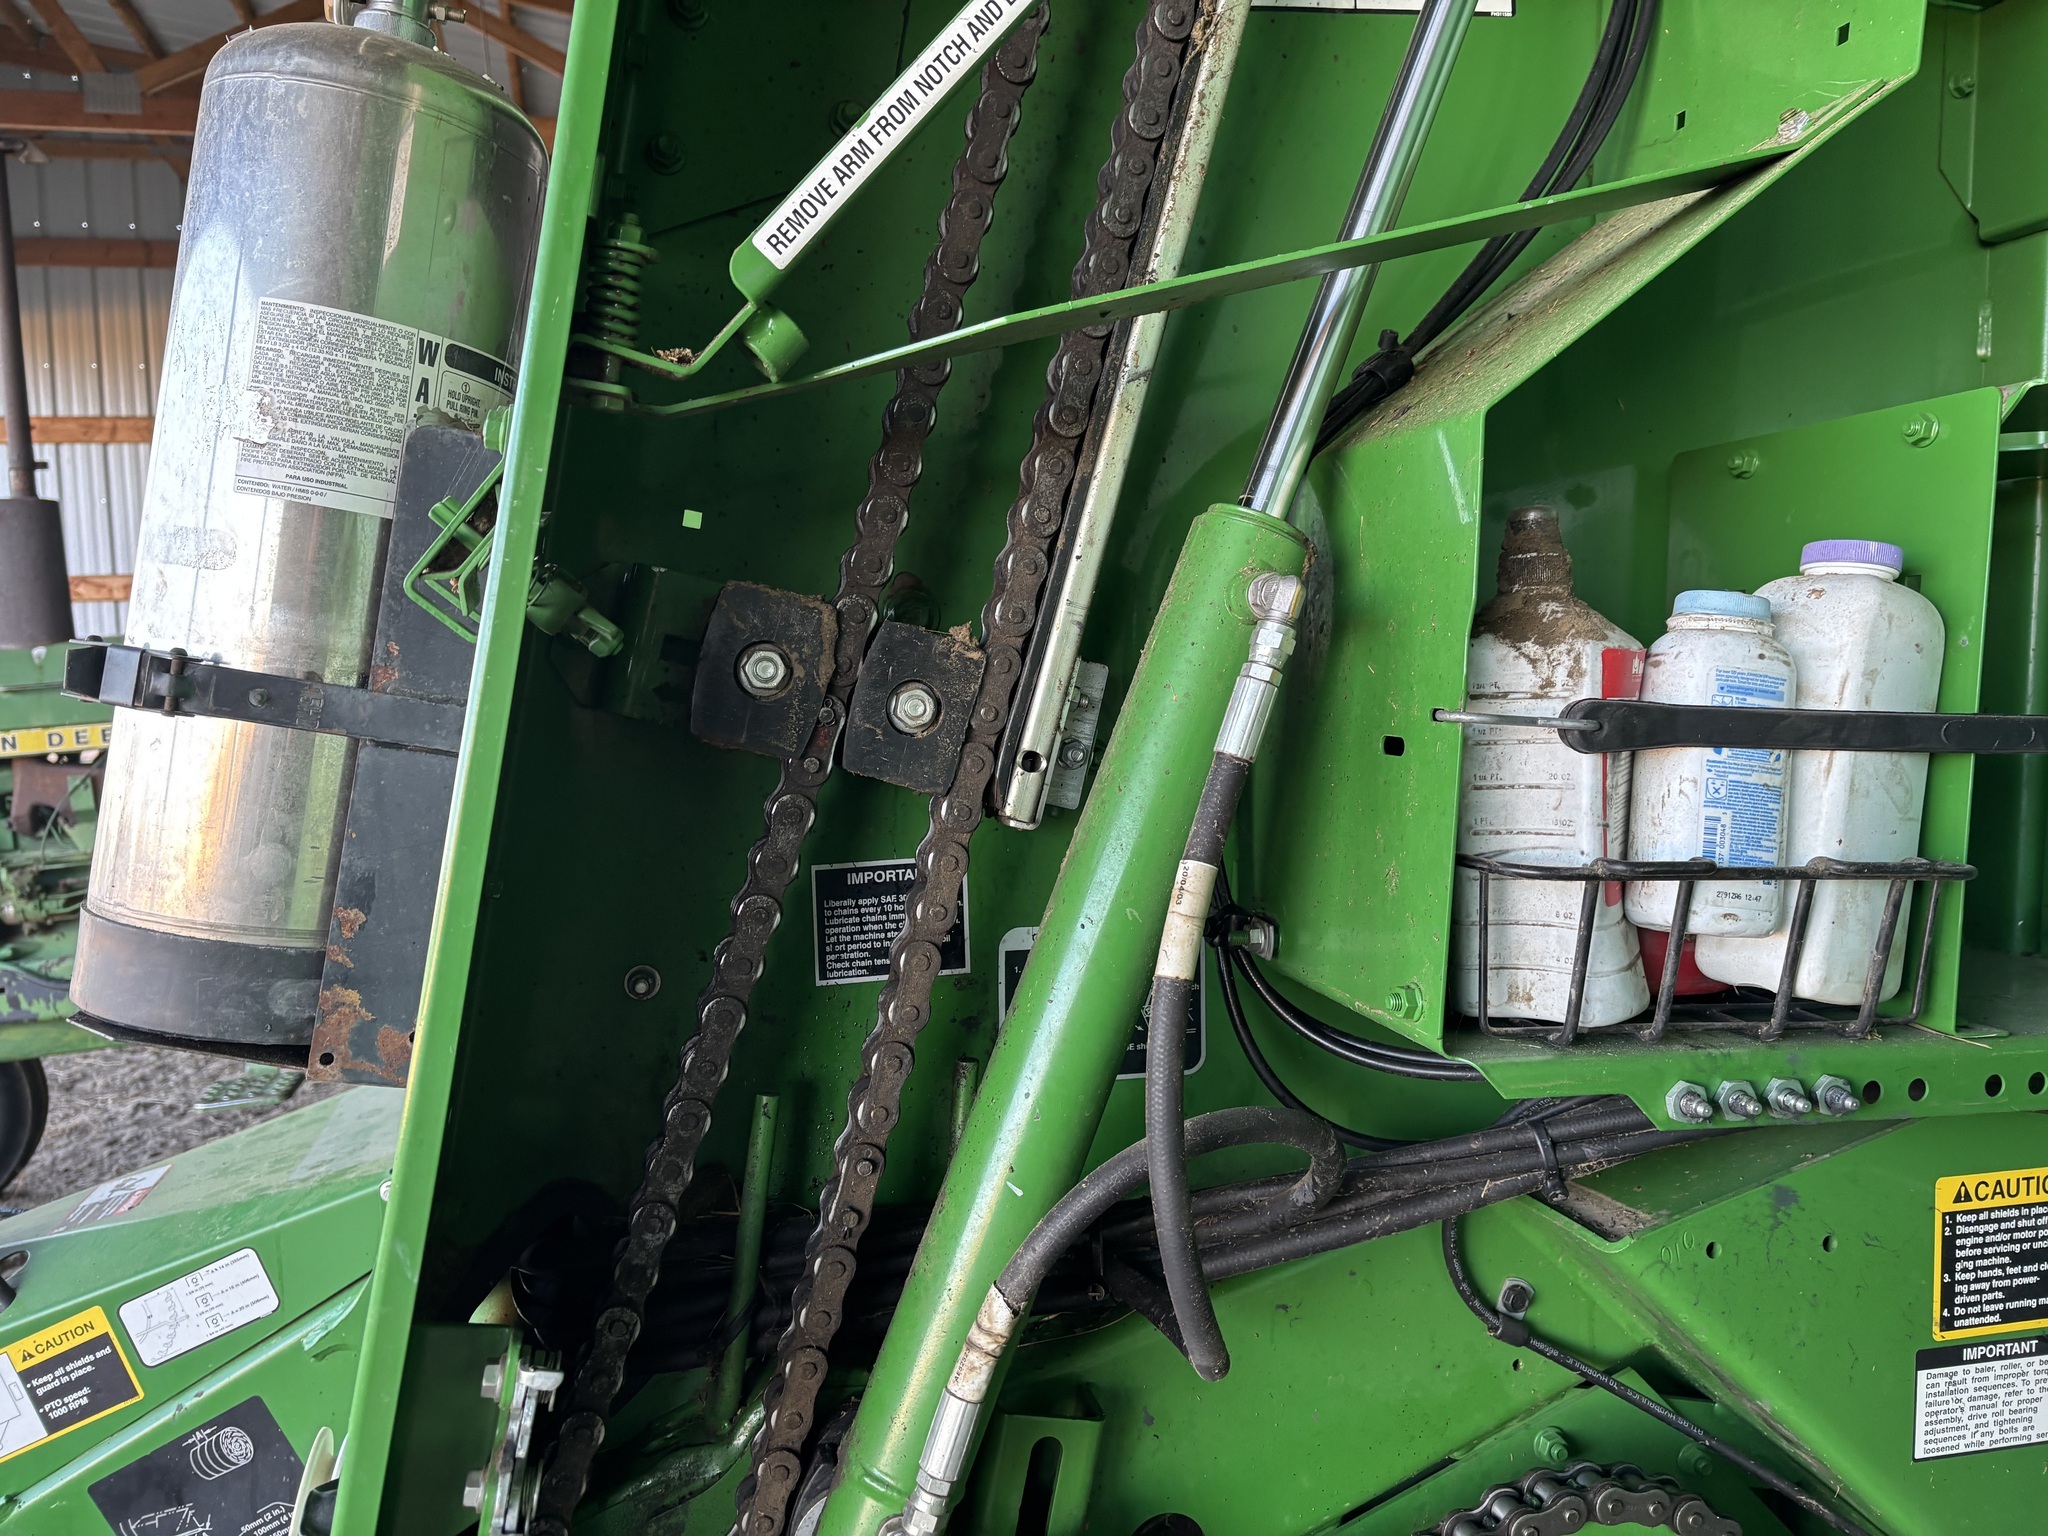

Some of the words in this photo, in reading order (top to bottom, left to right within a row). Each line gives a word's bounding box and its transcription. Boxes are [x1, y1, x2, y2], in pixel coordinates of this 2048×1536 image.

[766, 178, 837, 254] REMOVE
[832, 138, 874, 186] ARM
[867, 89, 920, 145] FROM
[913, 33, 971, 96] NOTCH
[967, 0, 1002, 42] AND
[309, 309, 350, 320] INSPECCIONAR
[352, 317, 396, 331] MENSUALMENTE
[447, 389, 461, 400] HOLD
[445, 399, 458, 411] PULL
[314, 478, 347, 489] INDUSTRIAL
[236, 485, 270, 495] CONTENIDOS
[286, 492, 311, 501] PRESION
[847, 868, 917, 884] IMPORTA
[1175, 866, 1190, 905] 20/04/03
[824, 898, 856, 907] Liberally
[858, 896, 878, 906] apply
[824, 916, 860, 925] Lubricate
[861, 914, 886, 922] chains
[833, 907, 858, 915] chains
[825, 925, 860, 935] operation
[852, 931, 884, 940] machine
[847, 941, 871, 952] period
[826, 960, 850, 969] Check
[826, 968, 868, 977] lubrication.
[1945, 1215, 1952, 1223] 1.
[1956, 1213, 1977, 1222] Keep
[1978, 1210, 1988, 1220] all
[1990, 1208, 2019, 1218] shields
[2021, 1206, 2029, 1215] in
[2030, 1205, 2048, 1216] plac
[1944, 1226, 1951, 1235] 2.
[1956, 1223, 1998, 1234] Disengage
[2000, 1219, 2015, 1229] and
[2017, 1217, 2035, 1227] shut
[2036, 1216, 2048, 1225] off
[1955, 1236, 1983, 1246] engine
[1985, 1232, 2011, 1242] and/or
[2012, 1230, 2036, 1239] motor
[1955, 1248, 1981, 1257] before
[1983, 1242, 2020, 1254] servicing
[1955, 1260, 1973, 1271] ging
[1975, 1255, 2011, 1266] machine.
[1943, 1274, 1950, 1282] 3.
[1955, 1272, 1975, 1281] Keep
[1977, 1267, 2004, 1278] hands,
[2006, 1265, 2021, 1274] feet
[2022, 1262, 2038, 1272] and
[1954, 1284, 1968, 1293] ing
[1969, 1281, 1990, 1290] away
[1992, 1279, 2010, 1287] from
[2012, 1276, 2040, 1287] power-
[1954, 1294, 1980, 1304] driven
[1981, 1290, 2004, 1302] parts.
[1942, 1308, 1950, 1316] 4.
[1954, 1306, 1965, 1315] Do
[1967, 1304, 1981, 1314] not
[1982, 1302, 2004, 1311] leave
[2005, 1298, 2036, 1309] running
[1954, 1313, 2001, 1327] unattended.
[34, 1320, 94, 1354] CAUTION
[1963, 1340, 2037, 1360] IMPORTANT
[31, 1373, 53, 1386] Keep
[54, 1366, 64, 1376] all
[65, 1354, 94, 1371] shields
[95, 1345, 111, 1358] and
[1566, 1356, 1608, 1382] HYDRAULIC
[1926, 1370, 1958, 1380] Damage
[2000, 1362, 2022, 1370] roller,
[36, 1378, 60, 1396] guard
[69, 1365, 95, 1380] place.
[1944, 1377, 1966, 1387] result
[1993, 1370, 2029, 1381] improper
[1925, 1387, 1968, 1398] installation
[1973, 1381, 2017, 1392] sequences.
[44, 1398, 62, 1411] PTO
[63, 1386, 90, 1403] speed:
[48, 1406, 68, 1418] 1000
[68, 1396, 88, 1410] RPM
[1626, 1388, 1676, 1420] HYDRAULICS
[1924, 1406, 1964, 1417] operator's
[1969, 1401, 1997, 1411] manual
[2017, 1396, 2042, 1406] proper
[1925, 1399, 1950, 1408] failure
[1967, 1393, 2000, 1402] damage,
[1924, 1416, 1963, 1426] assembly,
[1991, 1409, 2004, 1417] roll
[2008, 1406, 2037, 1415] bearing
[1678, 1417, 1703, 1436] ATLAS
[1924, 1423, 1970, 1436] adjustment,
[1974, 1420, 1989, 1428] and
[1993, 1416, 2032, 1427] tightening
[1923, 1434, 1966, 1445] sequences
[1998, 1426, 2018, 1434] bolts
[1923, 1443, 1959, 1454] loosened
[1964, 1440, 1984, 1448] while
[1989, 1434, 2031, 1446] performing
[240, 1518, 263, 1534] 50mm
[263, 1512, 272, 1521] (2
[271, 1505, 285, 1516] in.)
[253, 1520, 280, 1536] 100mm
